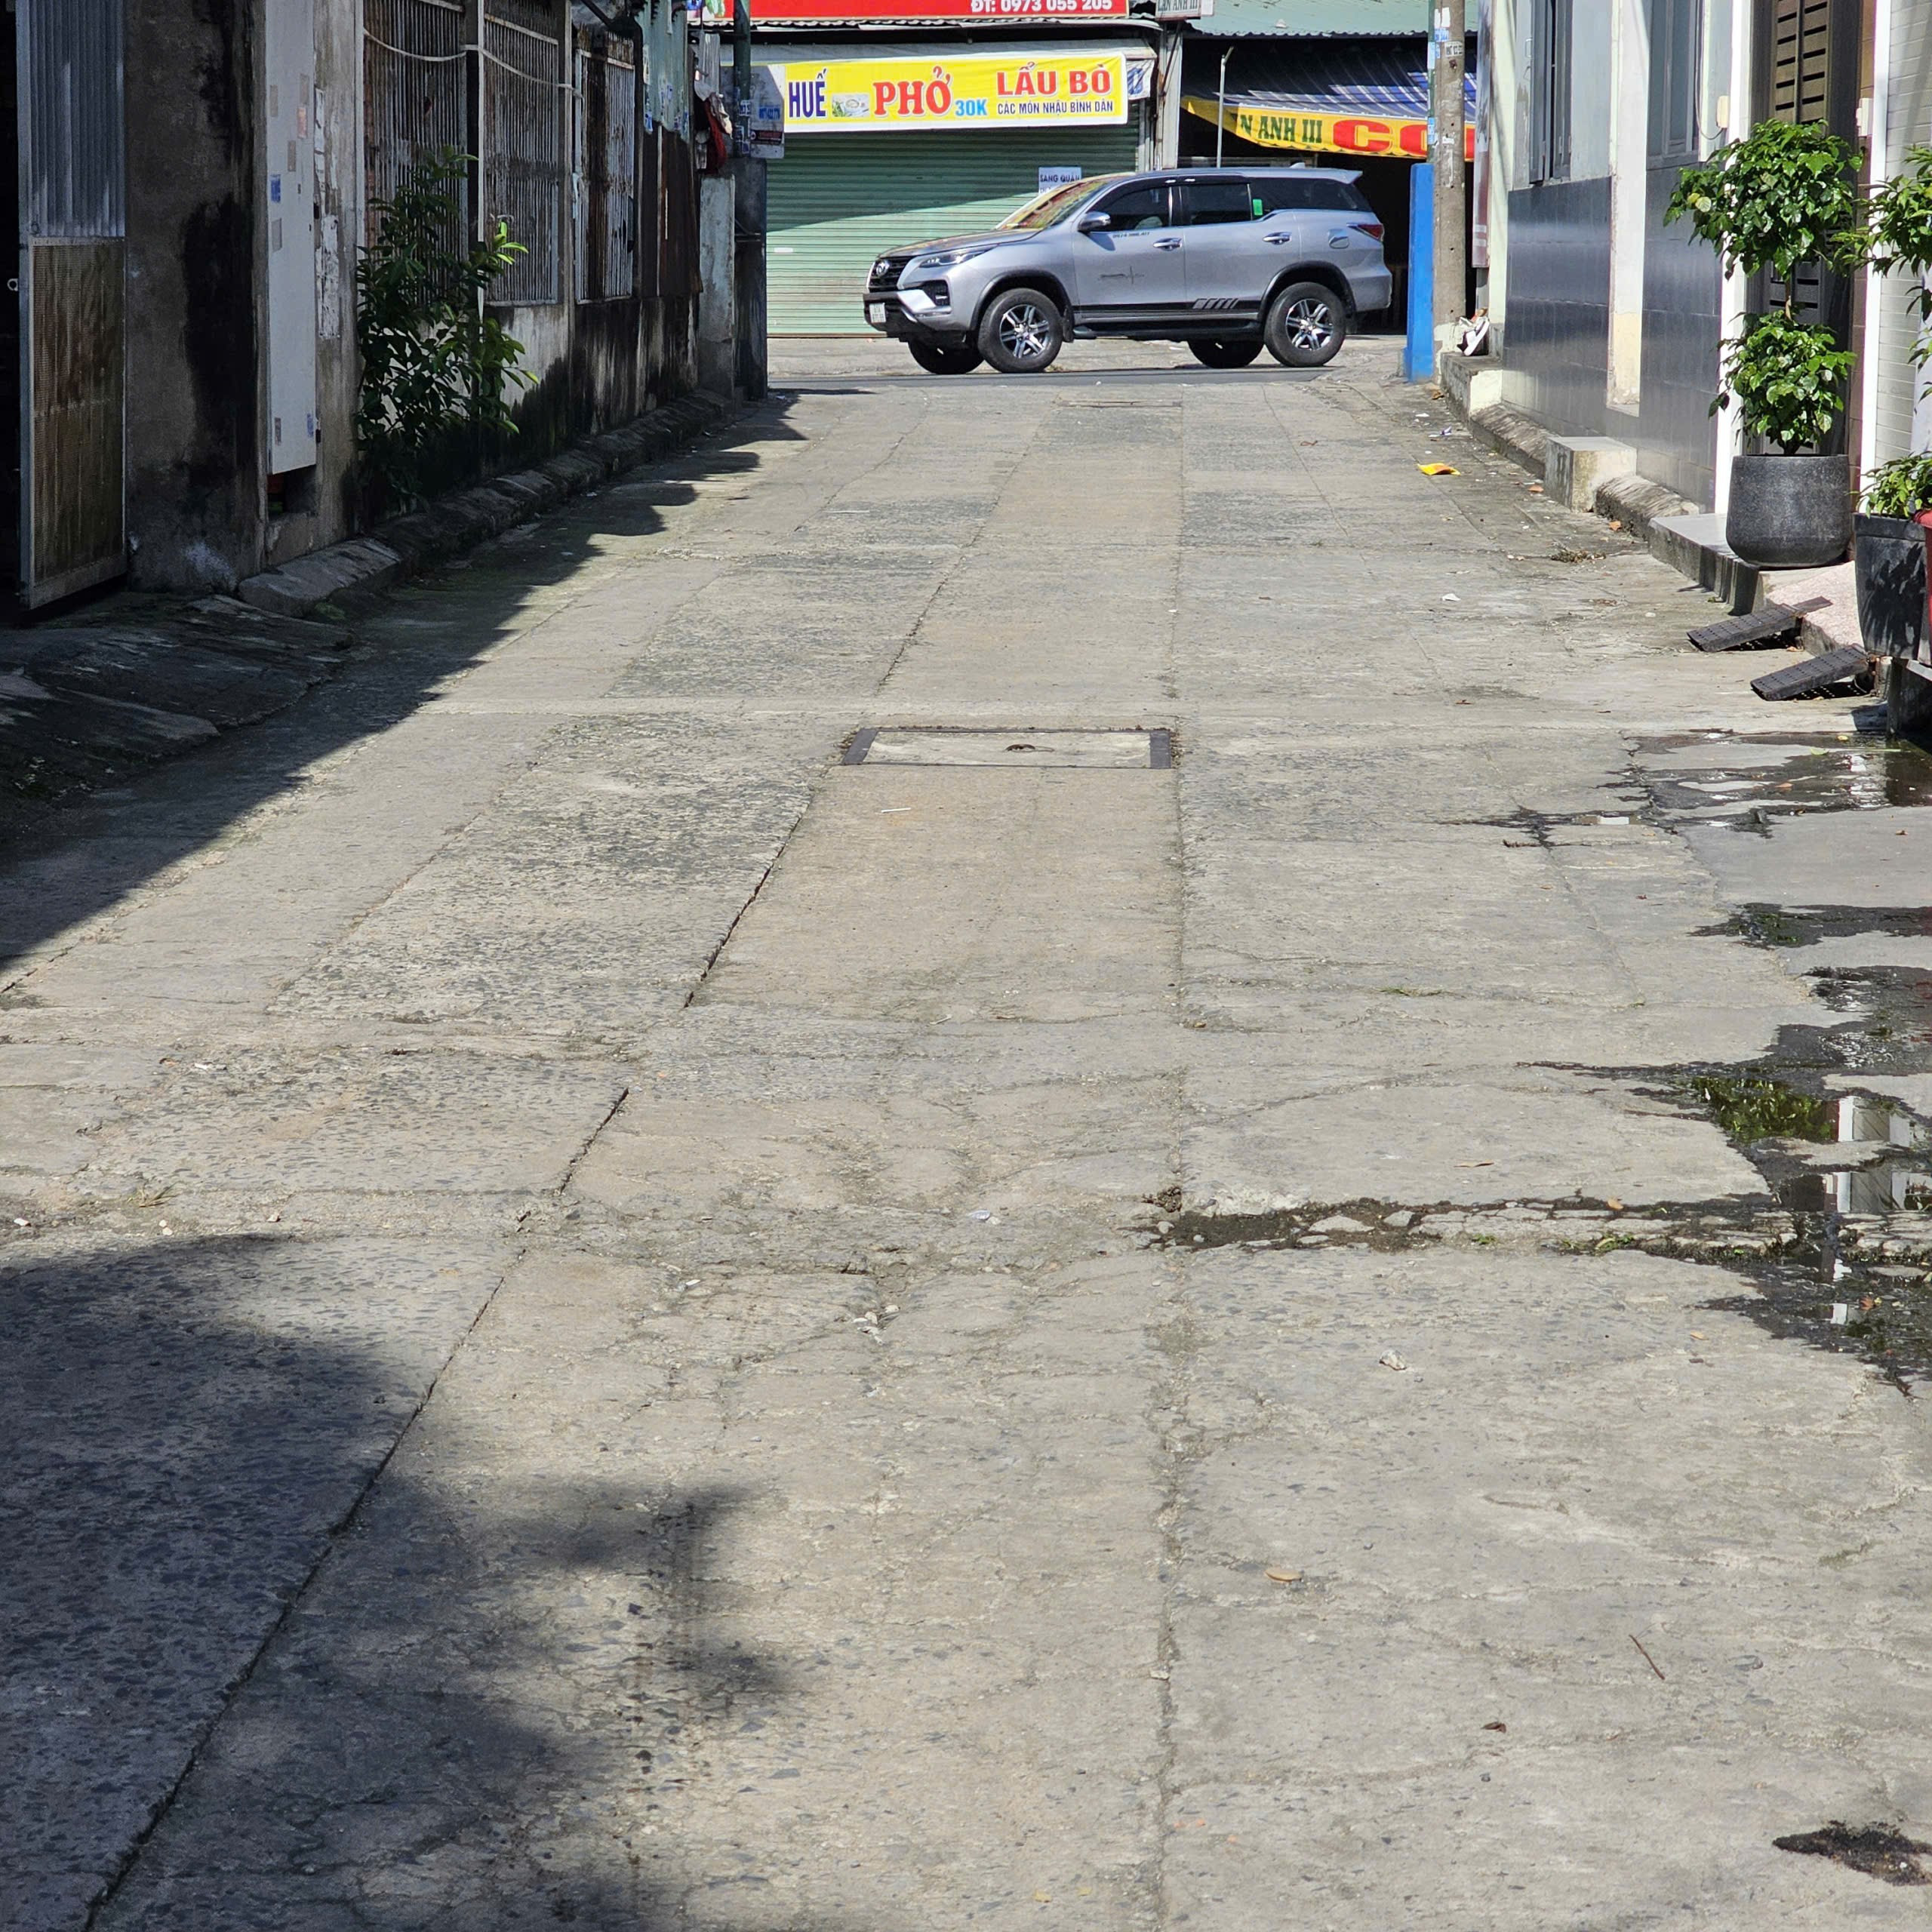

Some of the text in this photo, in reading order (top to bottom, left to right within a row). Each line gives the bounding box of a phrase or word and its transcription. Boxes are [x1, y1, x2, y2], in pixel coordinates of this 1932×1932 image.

[1001, 0, 1042, 12] 0973
[1047, 0, 1078, 11] 055
[1081, 0, 1112, 10] 205
[789, 68, 826, 118] HUẾ
[872, 66, 951, 116] PHỞ
[955, 99, 987, 116] 30K
[997, 61, 1057, 96] LẨU
[998, 100, 1016, 115] CÁC
[1043, 99, 1067, 116] NHẬU
[1094, 98, 1113, 112] DÂN
[1258, 115, 1297, 142] ANH
[1302, 119, 1322, 143] III
